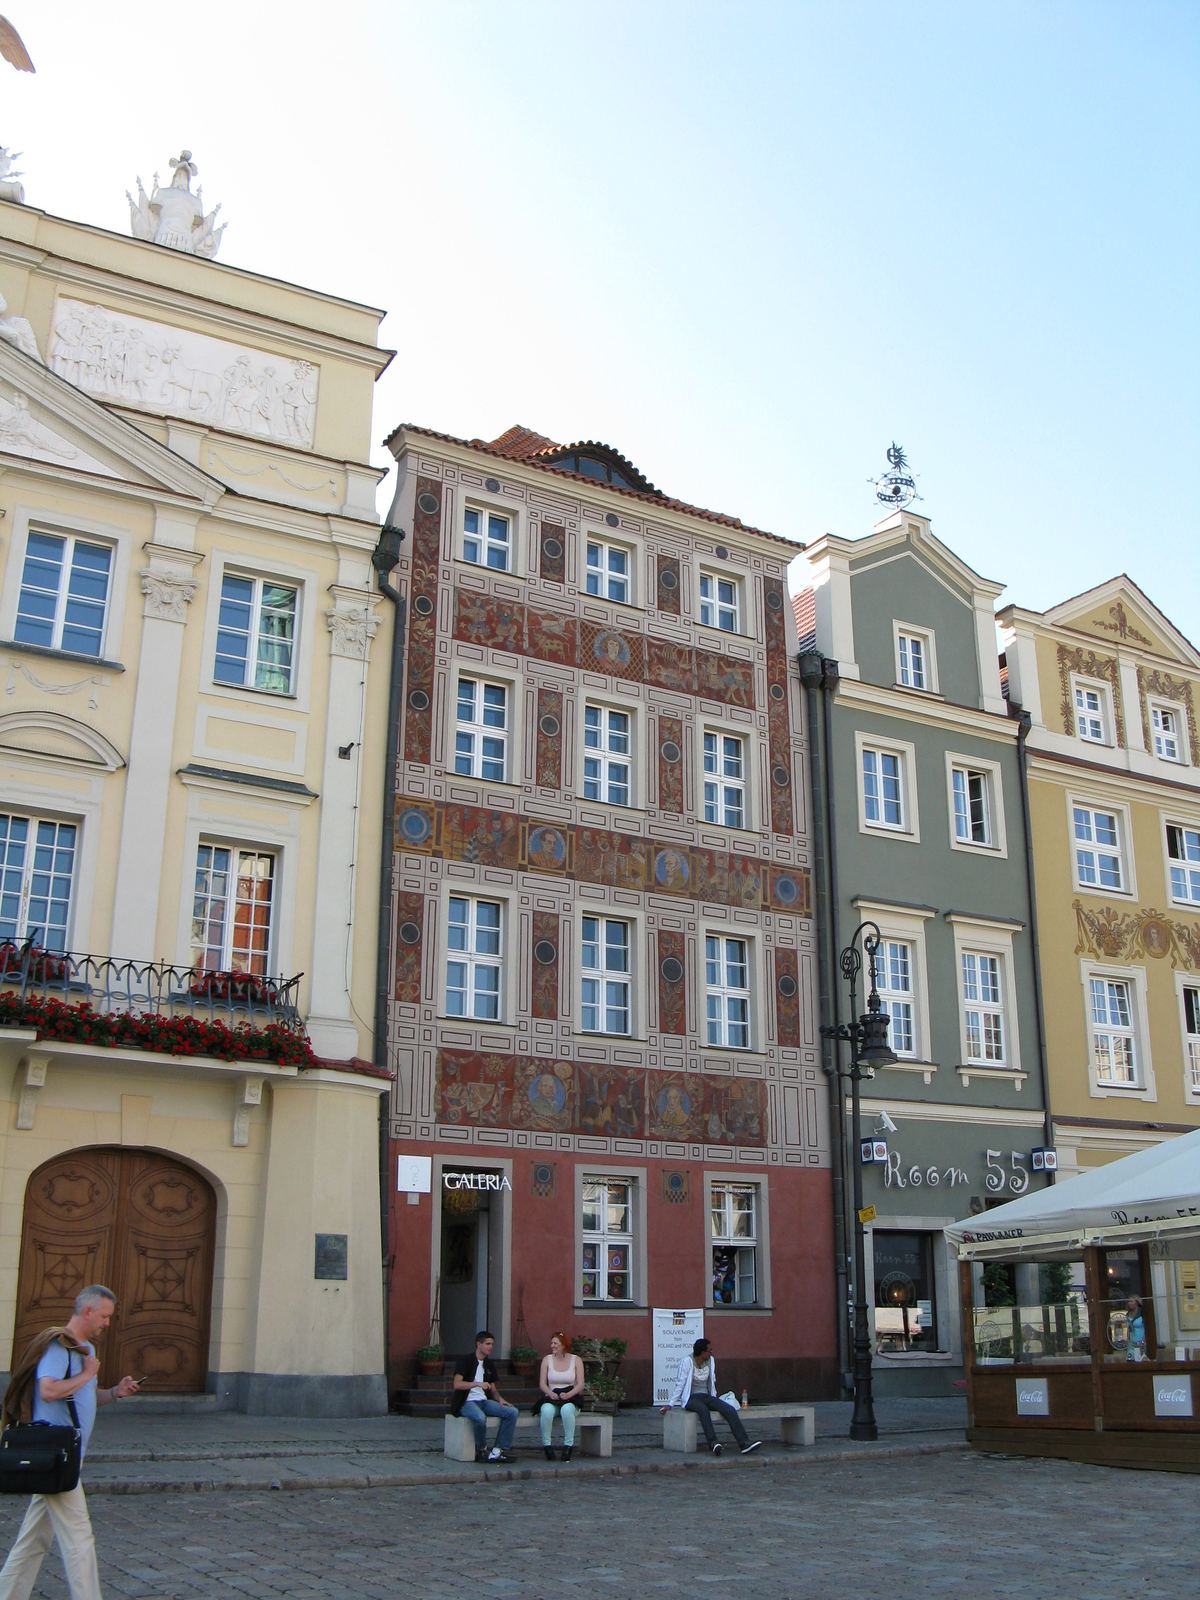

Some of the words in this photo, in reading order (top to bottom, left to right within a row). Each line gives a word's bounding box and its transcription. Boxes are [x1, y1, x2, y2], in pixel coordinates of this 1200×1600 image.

[885, 1151, 970, 1188] Room
[985, 1149, 1030, 1193] 55
[444, 1173, 512, 1191] GALERIA
[975, 1229, 1025, 1242] PAULANER
